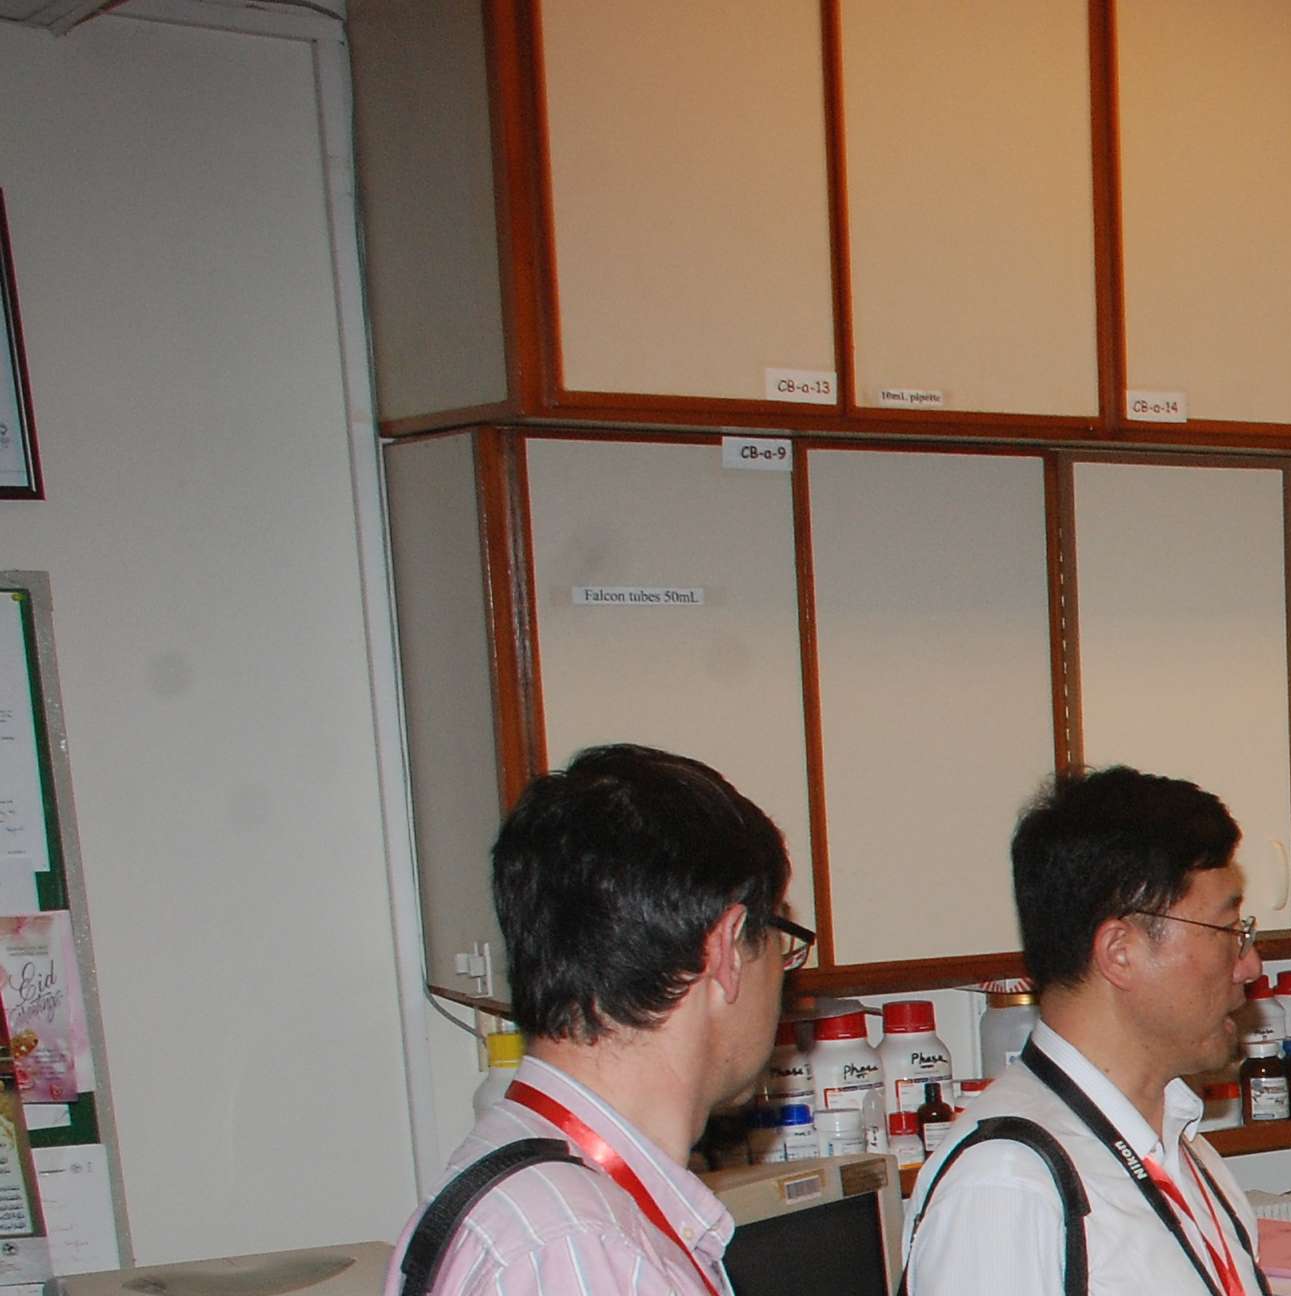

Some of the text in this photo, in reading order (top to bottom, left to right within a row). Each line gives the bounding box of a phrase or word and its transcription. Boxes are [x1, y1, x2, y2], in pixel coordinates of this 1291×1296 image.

[777, 379, 831, 395] CB-a-13
[1132, 400, 1179, 414] CB-a-14
[740, 445, 787, 460] CB-a-9
[584, 588, 700, 603] Falcon tubes 50mL
[911, 1051, 948, 1066] Phase
[1114, 1140, 1148, 1180] Nikon
